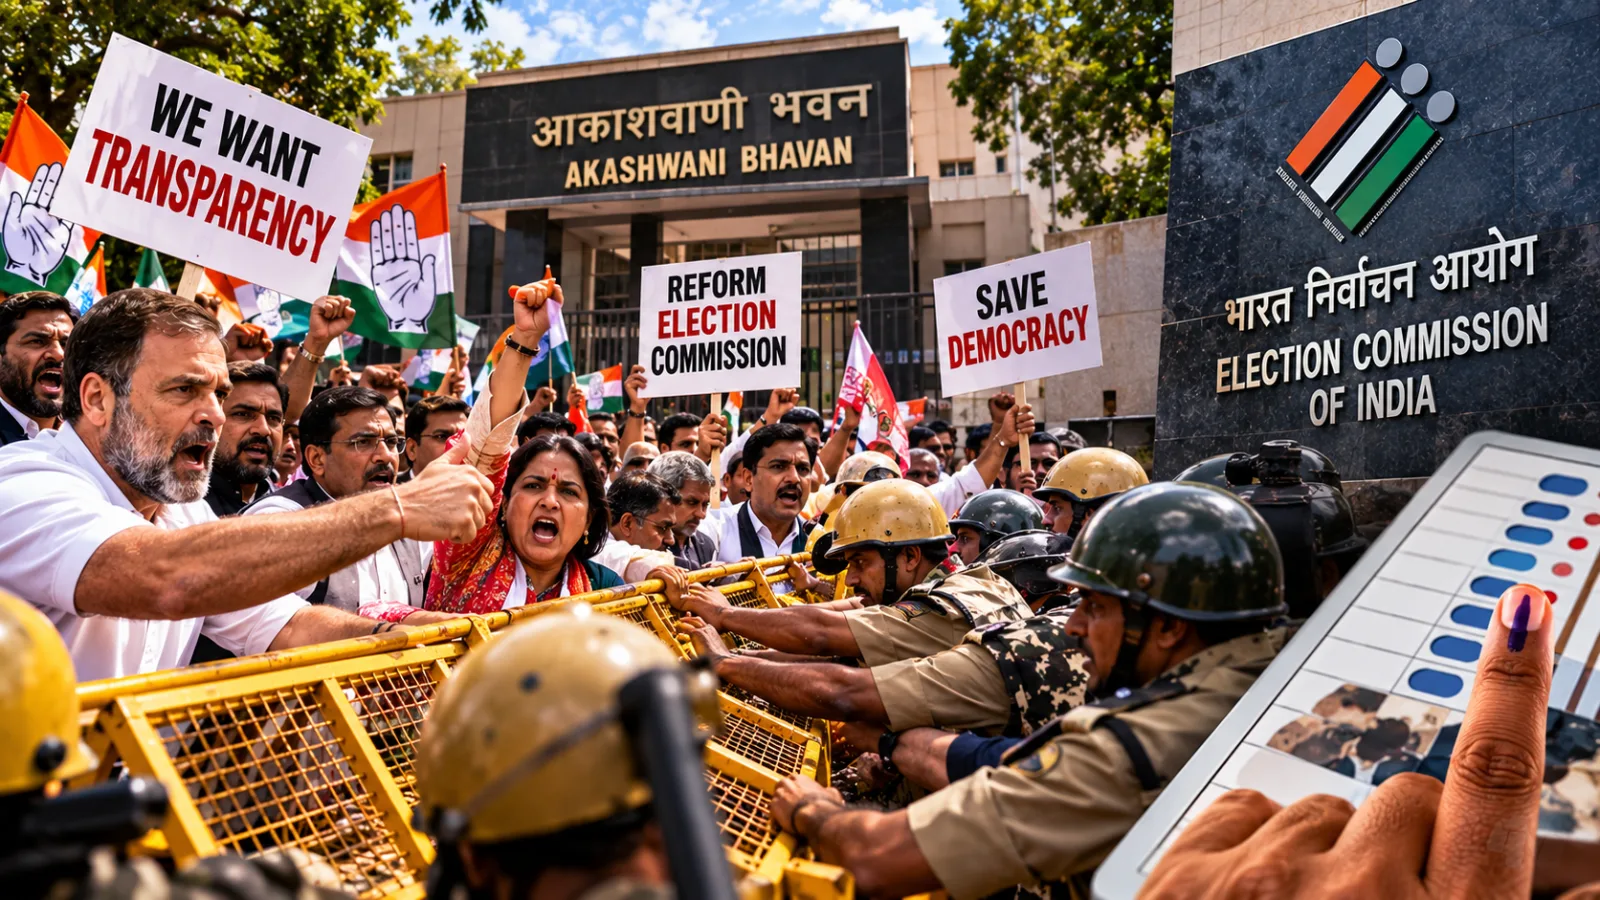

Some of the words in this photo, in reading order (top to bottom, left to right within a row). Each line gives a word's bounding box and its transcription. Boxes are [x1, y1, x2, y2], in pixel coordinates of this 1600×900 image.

[150, 83, 213, 148] WE
[217, 108, 321, 188] WANT
[531, 86, 748, 148] आकाशवाणी
[770, 83, 873, 124] भवन
[564, 147, 727, 189] AKASHWANI
[741, 136, 853, 173] BHAVAN
[85, 128, 336, 264] TRANSPARENCY
[667, 266, 766, 303] REFORM
[975, 270, 1048, 320] SAVE
[1224, 286, 1294, 331] भारत
[1304, 256, 1416, 318] निर्वाचन
[1429, 226, 1538, 291] आयोग
[657, 299, 776, 340] ELECTION
[947, 304, 1089, 370] DEMOCRACY
[1216, 338, 1341, 393] ELECTION
[1352, 302, 1548, 371] COMMISSION
[651, 335, 787, 376] COMMISSION
[1309, 386, 1345, 427] OF
[1357, 374, 1436, 421] INDIA
